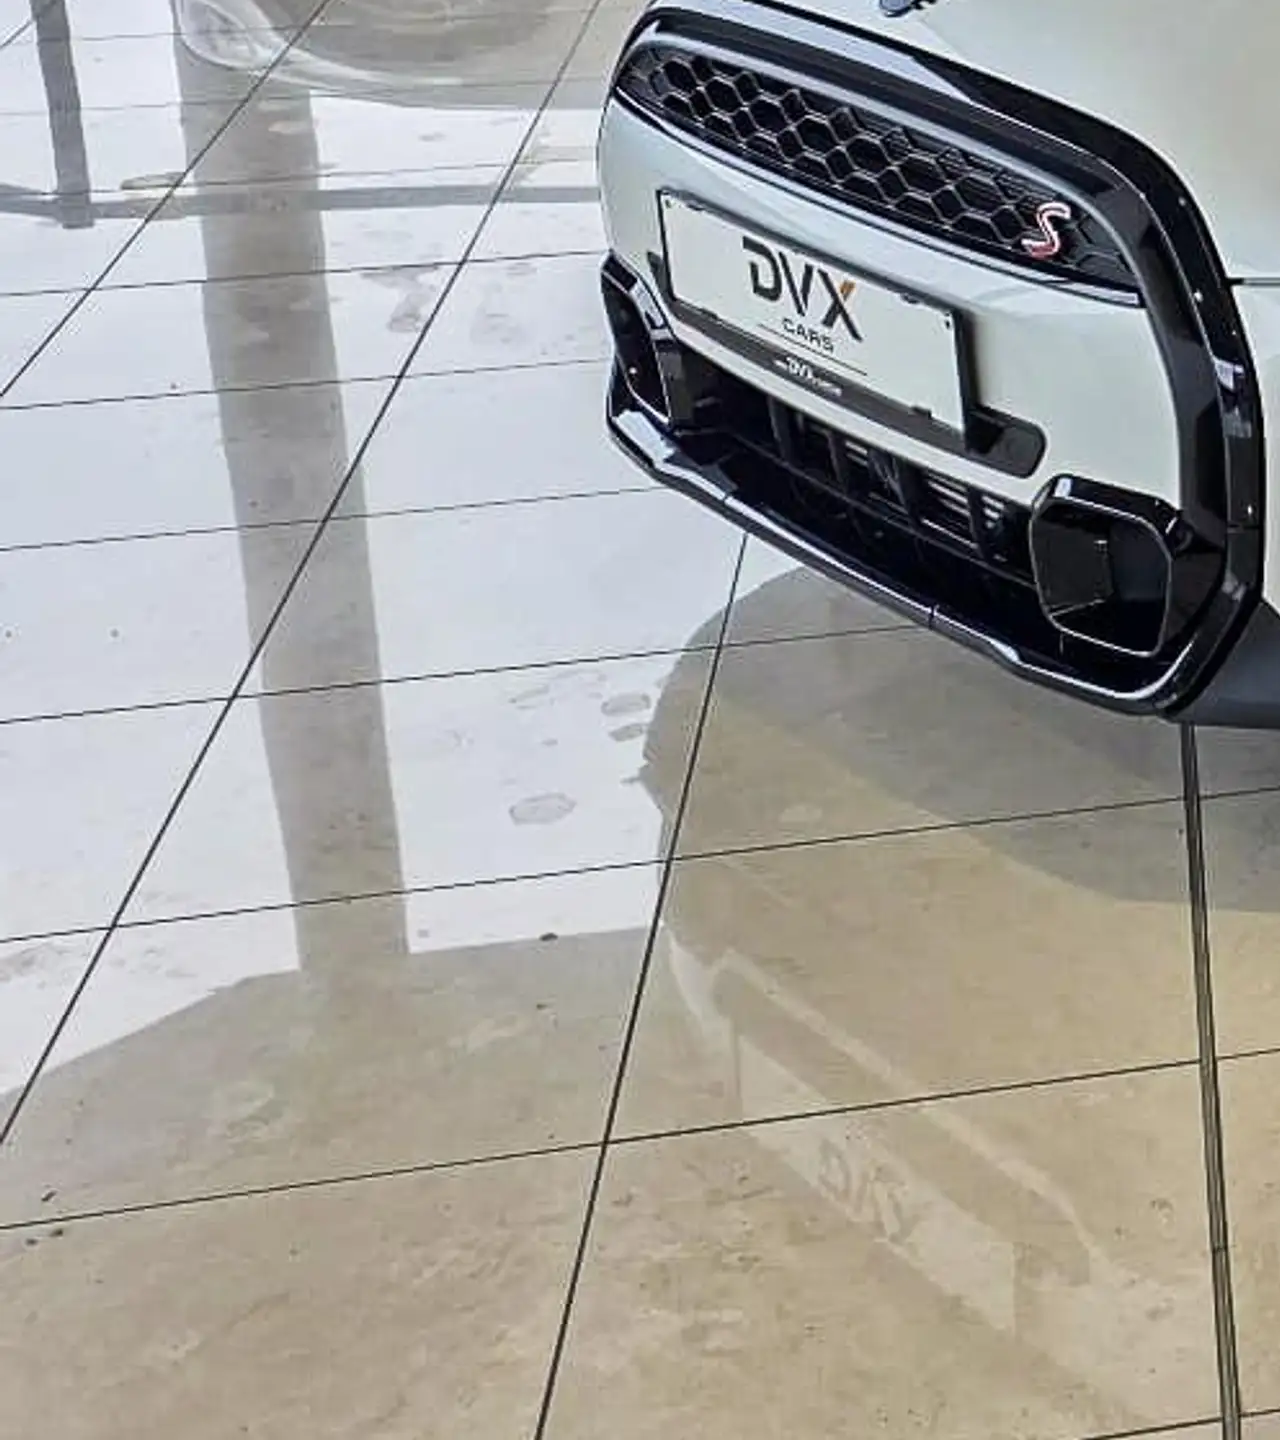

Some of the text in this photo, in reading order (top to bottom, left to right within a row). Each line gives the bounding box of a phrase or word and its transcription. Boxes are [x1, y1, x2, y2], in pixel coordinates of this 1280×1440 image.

[1021, 201, 1071, 258] S
[742, 235, 864, 343] DVX
[780, 317, 834, 354] CARS
